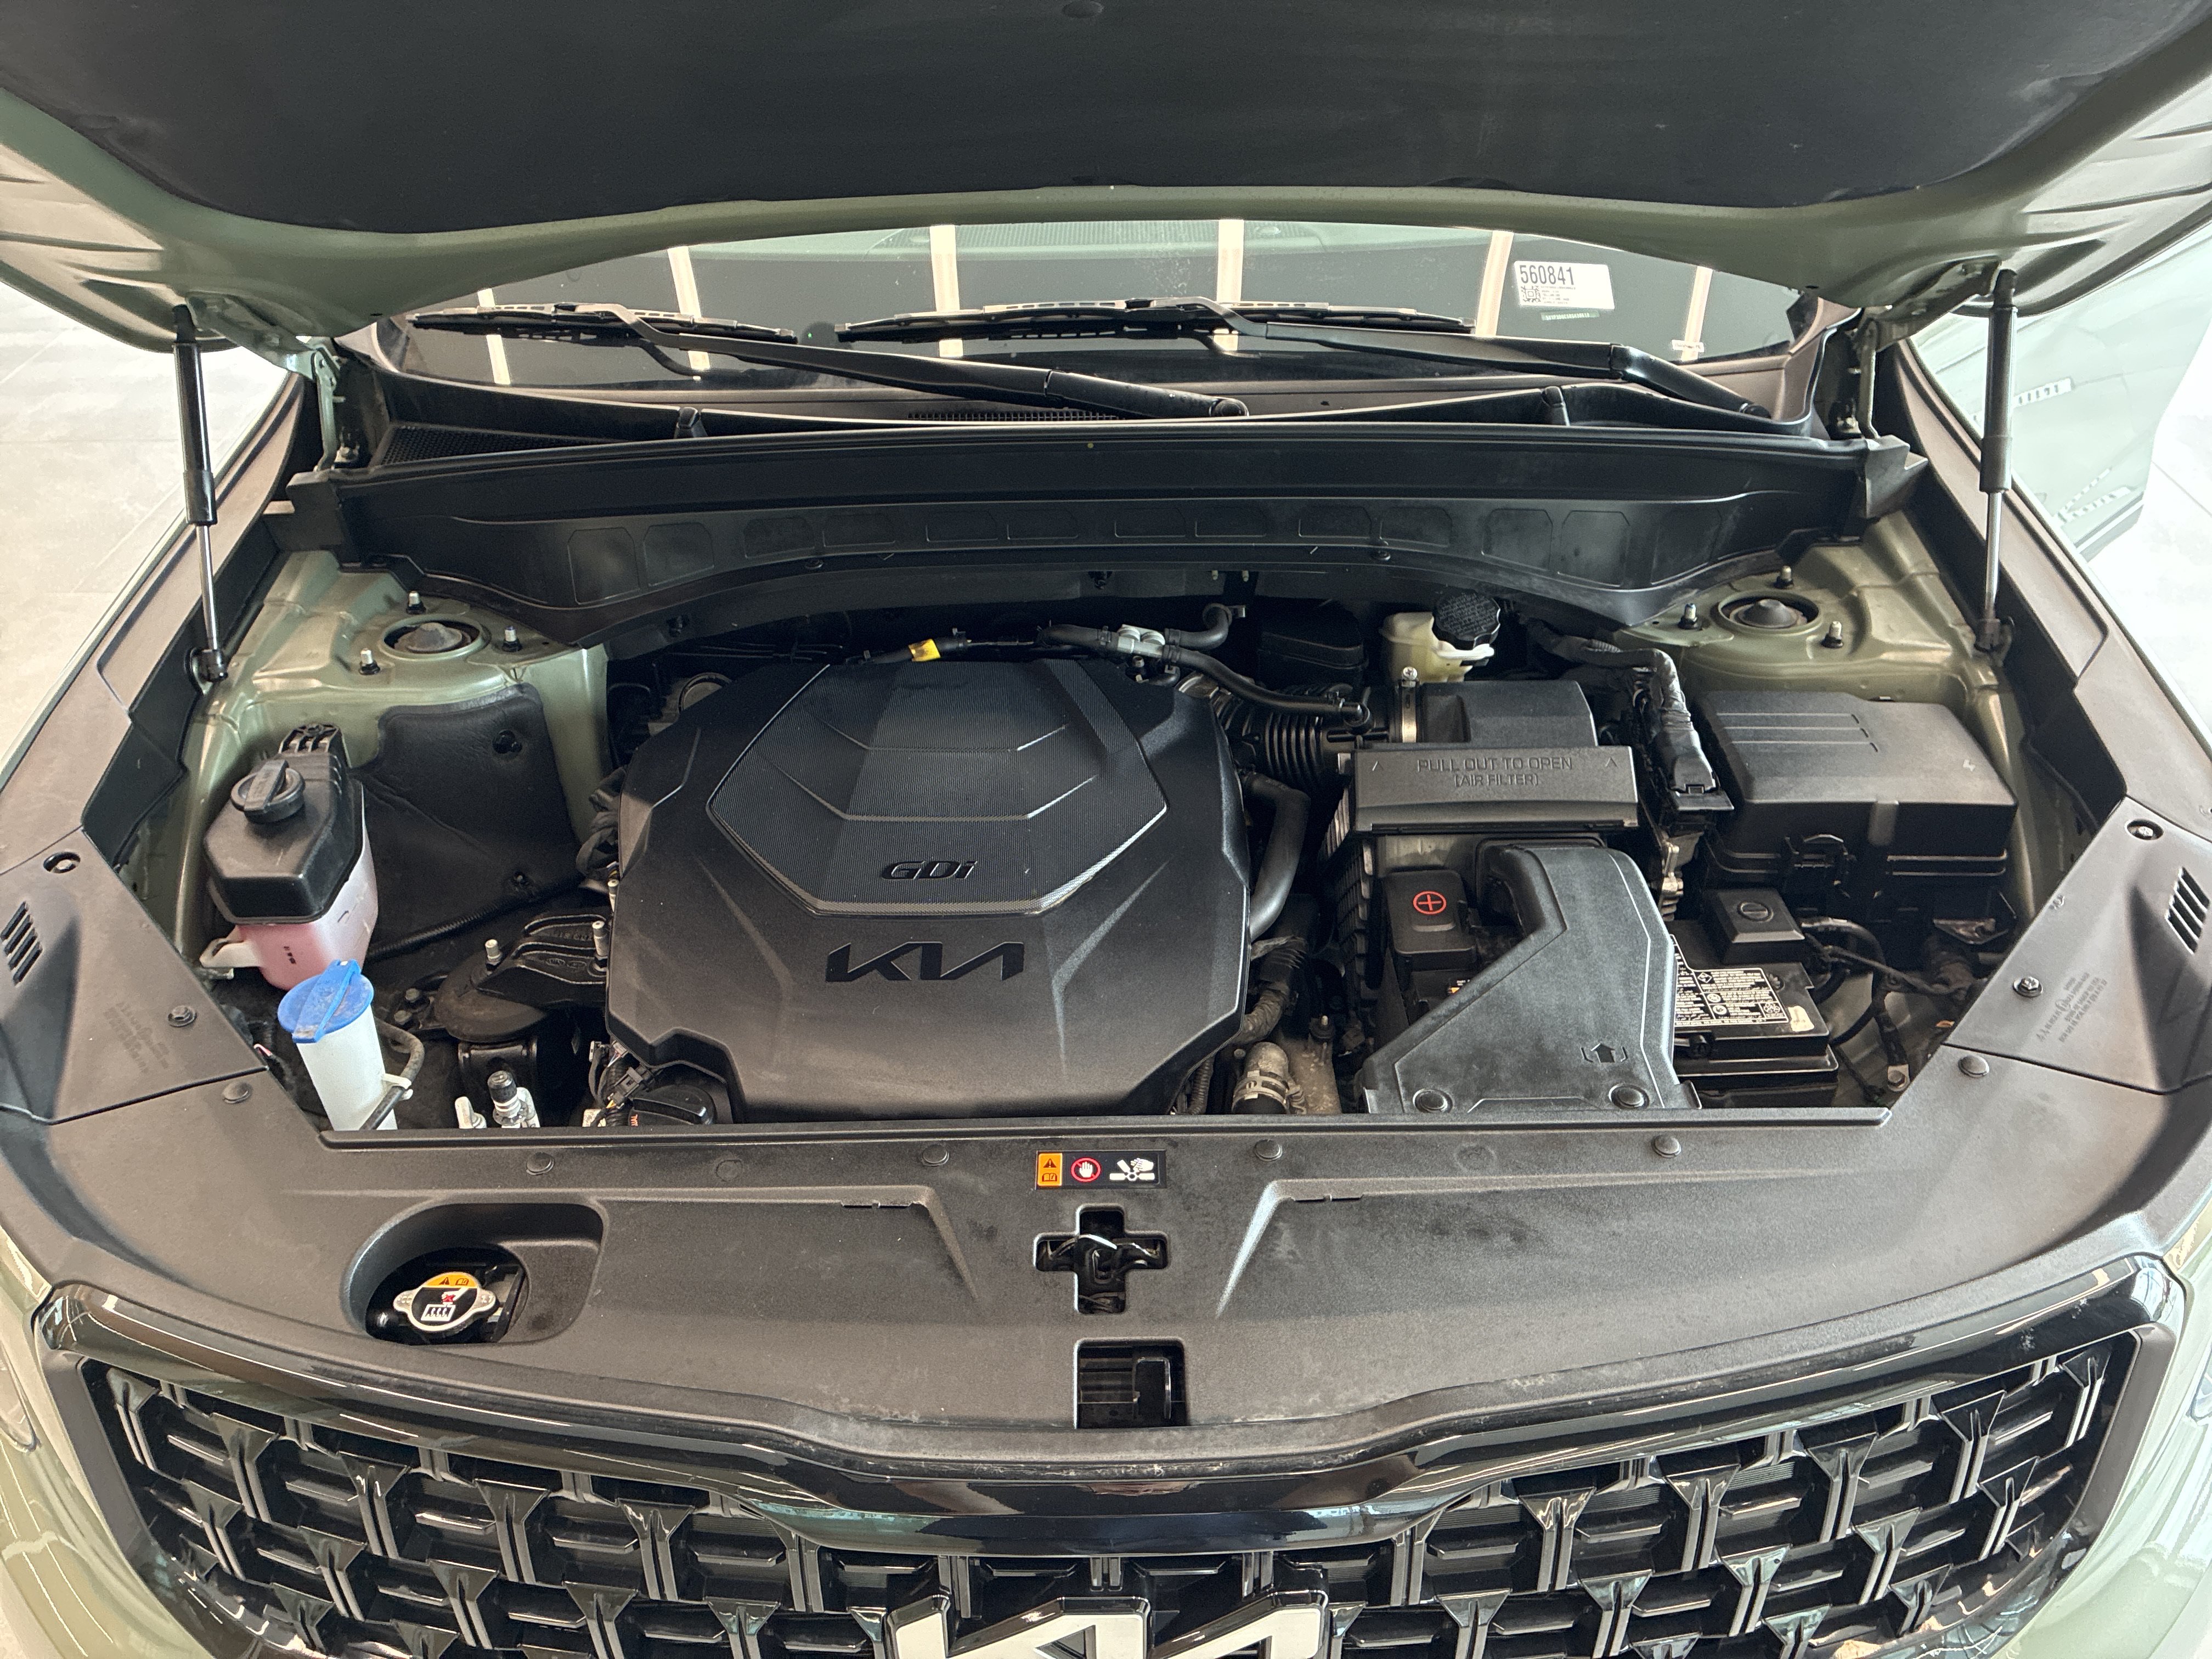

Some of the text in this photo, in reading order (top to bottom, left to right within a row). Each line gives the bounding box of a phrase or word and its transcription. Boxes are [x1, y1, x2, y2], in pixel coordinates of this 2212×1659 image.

[1519, 264, 1575, 285] 560841
[1417, 756, 1573, 772] PULL OUT TO OPEN
[881, 860, 979, 880] GDi
[825, 941, 1025, 983] KIA
